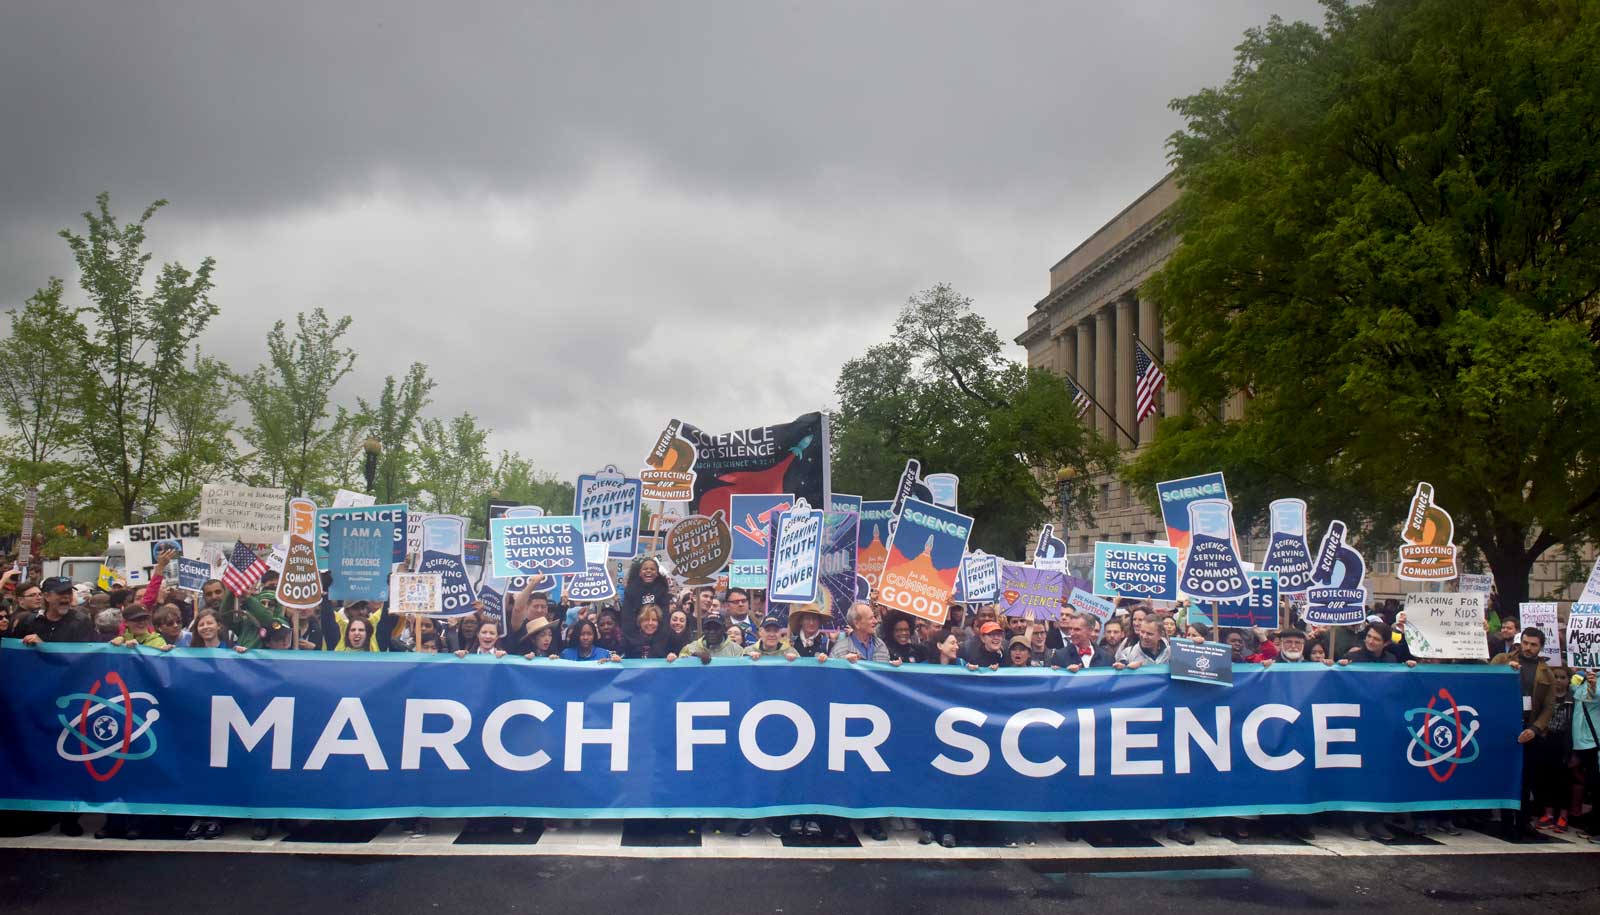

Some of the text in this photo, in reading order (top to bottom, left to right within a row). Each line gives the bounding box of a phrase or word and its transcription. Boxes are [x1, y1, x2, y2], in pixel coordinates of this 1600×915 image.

[656, 424, 676, 457] SCIENCE
[691, 426, 774, 446] SCIENCE
[719, 442, 775, 458] SILENCE
[643, 472, 692, 481] PROTECTING
[586, 480, 625, 494] SCIENCE
[644, 488, 690, 499] OMMUNITIES
[1161, 482, 1223, 502] SCIENCE
[583, 487, 636, 506] SPEAKING
[582, 500, 634, 520] TRUTH
[860, 510, 893, 520] CIENC
[1413, 491, 1428, 530] SCIENCE
[207, 518, 222, 527] THE
[226, 520, 258, 531] NATURAL
[503, 524, 571, 536] SCIENCE
[601, 520, 612, 528] TO
[784, 516, 810, 532] SCIENCE
[904, 508, 968, 540] SCIENCE
[130, 522, 200, 542] SCIENCE
[343, 528, 381, 537] I AM A
[672, 519, 717, 544] PURSUING
[781, 521, 817, 546] SPEAKING
[504, 536, 554, 546] BELONGS
[674, 527, 719, 555] TRUTH
[1196, 542, 1229, 552] SCIENCE
[1275, 539, 1302, 549] SCIENCE
[292, 544, 312, 555] SCIENCE
[504, 546, 574, 558] EVERYONE
[676, 541, 720, 564] SAVING THE
[780, 535, 816, 561] TRUTH
[1272, 550, 1304, 558] SERVING
[1322, 530, 1340, 572] SCIENCE
[1404, 546, 1452, 556] PROTECTING
[290, 556, 314, 566] SERVING
[342, 558, 380, 567] FOR SCIENCE
[677, 548, 721, 574] WORLD
[1105, 549, 1167, 563] SCIENCE
[426, 558, 458, 568] SCIENCE
[734, 564, 768, 574] SCIEN
[791, 559, 798, 568] TO
[968, 562, 994, 575] SPEAKING
[1104, 561, 1150, 571] BELONGS
[1268, 562, 1308, 573] COMMON
[180, 564, 210, 577] SCIENCE
[286, 572, 316, 582] COMMON
[968, 568, 994, 583] TRUTH
[1104, 570, 1166, 583] EVERYONE
[1190, 567, 1238, 577] COMMON
[1403, 566, 1454, 576] COMMUNITIES
[776, 566, 813, 592] POWER
[1187, 577, 1242, 592] GOOD
[1280, 571, 1311, 587] OOD
[283, 583, 318, 599] GOOD
[442, 583, 467, 595] MON
[572, 586, 609, 596] GOOD
[886, 572, 947, 602] COMMON
[969, 584, 996, 598] POWER
[882, 586, 942, 616] GOOD
[1312, 590, 1362, 599] PROTECTING
[1408, 594, 1478, 606] MARCHING FOR
[444, 594, 470, 609] OD
[1083, 597, 1100, 607] HAVE
[1570, 602, 1600, 613] SCIEN
[1072, 599, 1107, 618] SOLUTION
[1455, 608, 1478, 618] KIDS
[1309, 611, 1362, 621] COMMUNITIES
[1573, 653, 1600, 667] REAL
[209, 696, 1362, 776] MARCH FOR SCIENCE
